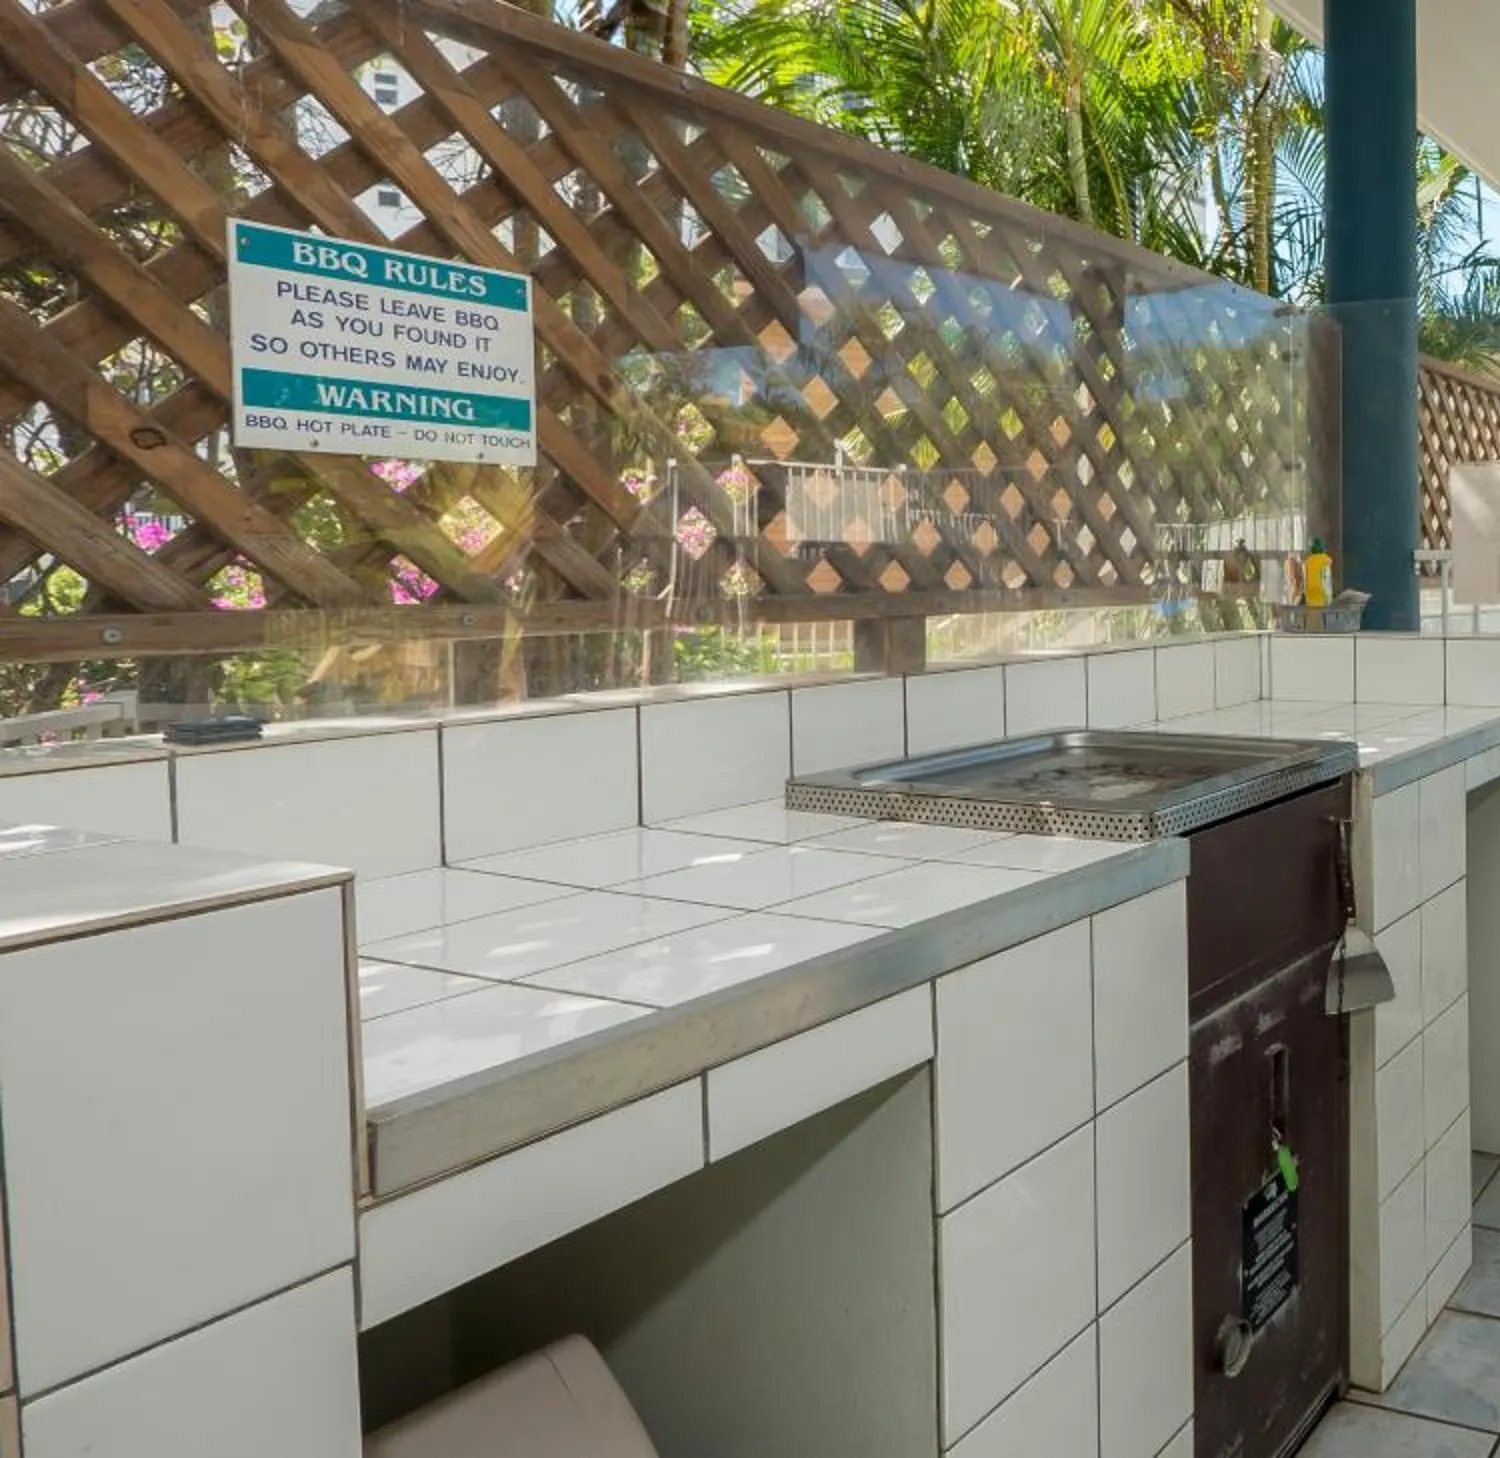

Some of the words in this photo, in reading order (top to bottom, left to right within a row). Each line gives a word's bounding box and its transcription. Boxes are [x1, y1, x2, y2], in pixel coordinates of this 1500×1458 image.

[291, 240, 369, 278] BBQ
[384, 258, 488, 296] RULES
[277, 281, 369, 311] PLEASE
[381, 297, 445, 323] LEAVE
[455, 309, 499, 331] BBQ
[291, 309, 323, 329] AS
[336, 315, 383, 337] YOU
[393, 324, 466, 349] FOUND
[476, 336, 492, 352] IT
[250, 333, 288, 354] SO
[300, 341, 396, 368] OTHERS
[406, 355, 447, 373] MAY
[317, 383, 476, 420] WARNING
[246, 415, 288, 430] BBQ
[297, 419, 332, 434] HOT
[341, 423, 390, 438] PLATE
[414, 429, 437, 443] DO
[445, 432, 475, 445] NOT
[483, 434, 530, 449] TOUCH
